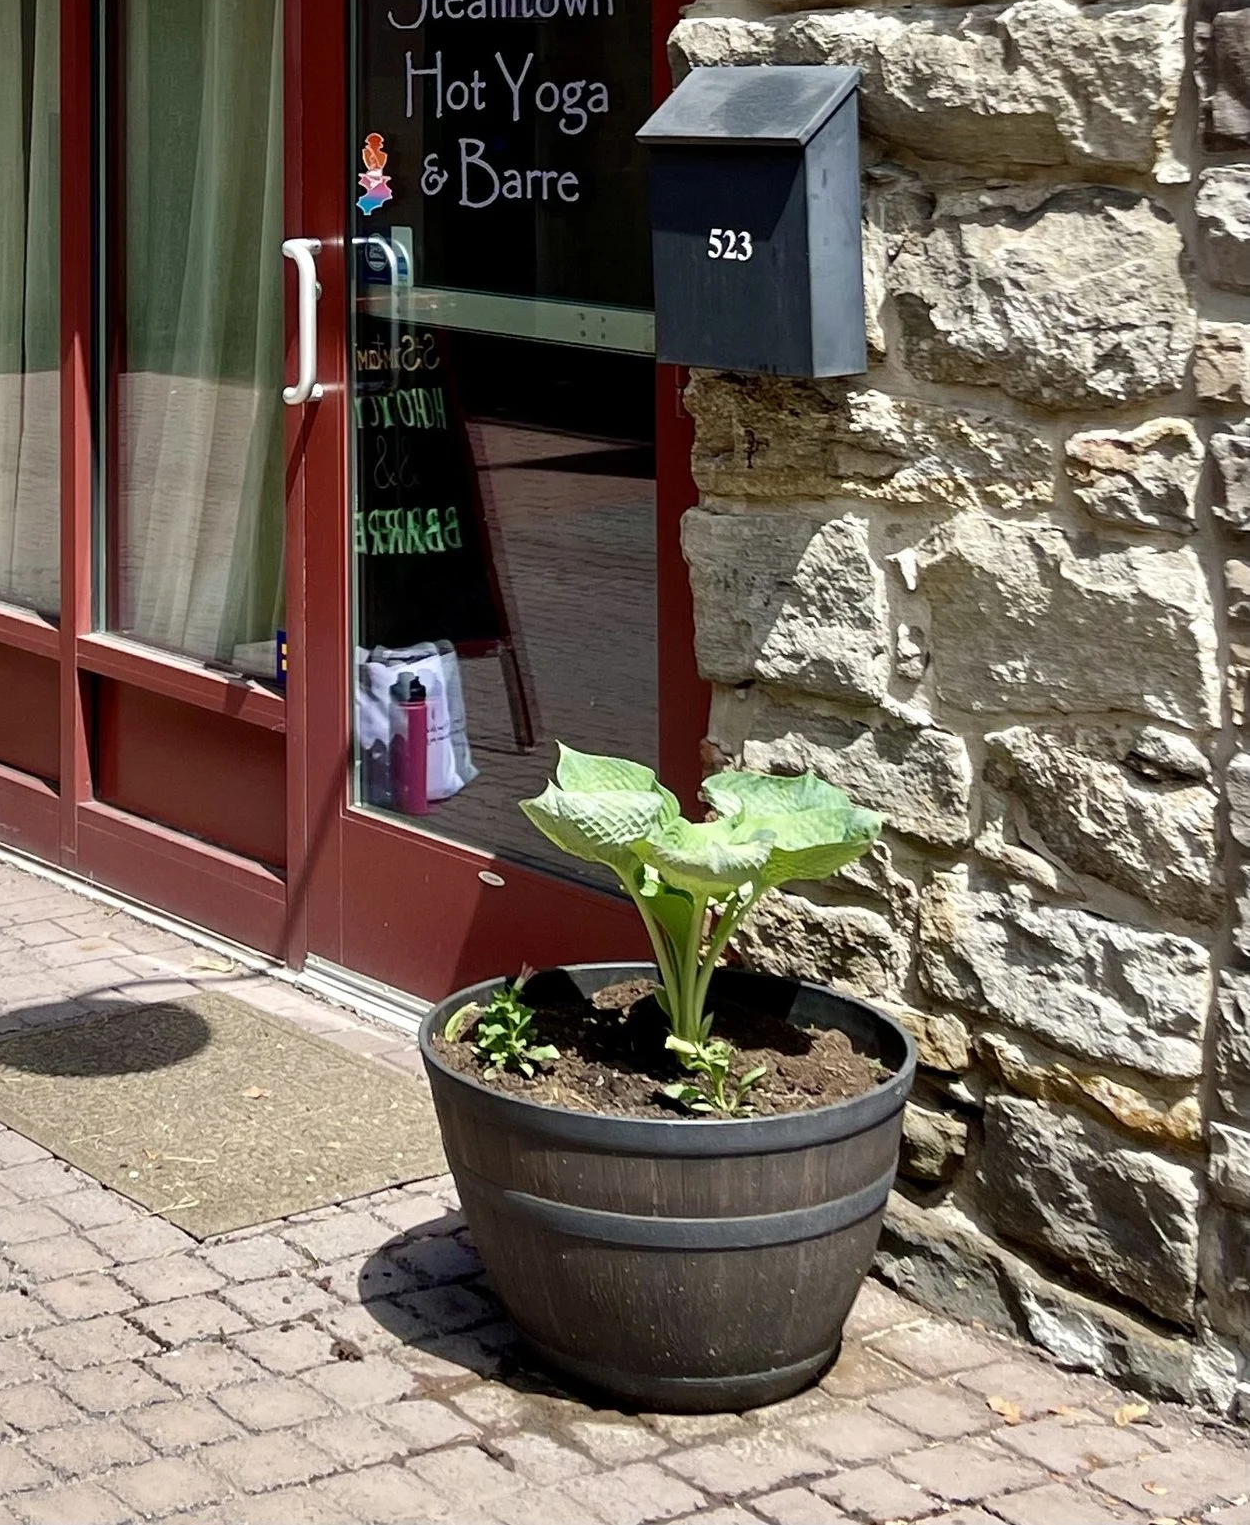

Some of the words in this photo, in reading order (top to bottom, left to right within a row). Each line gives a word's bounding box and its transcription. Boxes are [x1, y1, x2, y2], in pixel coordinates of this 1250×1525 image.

[405, 50, 487, 119] Hot
[494, 51, 610, 136] Yoga
[420, 153, 449, 196] &
[458, 137, 581, 209] Barre
[707, 228, 753, 262] 523
